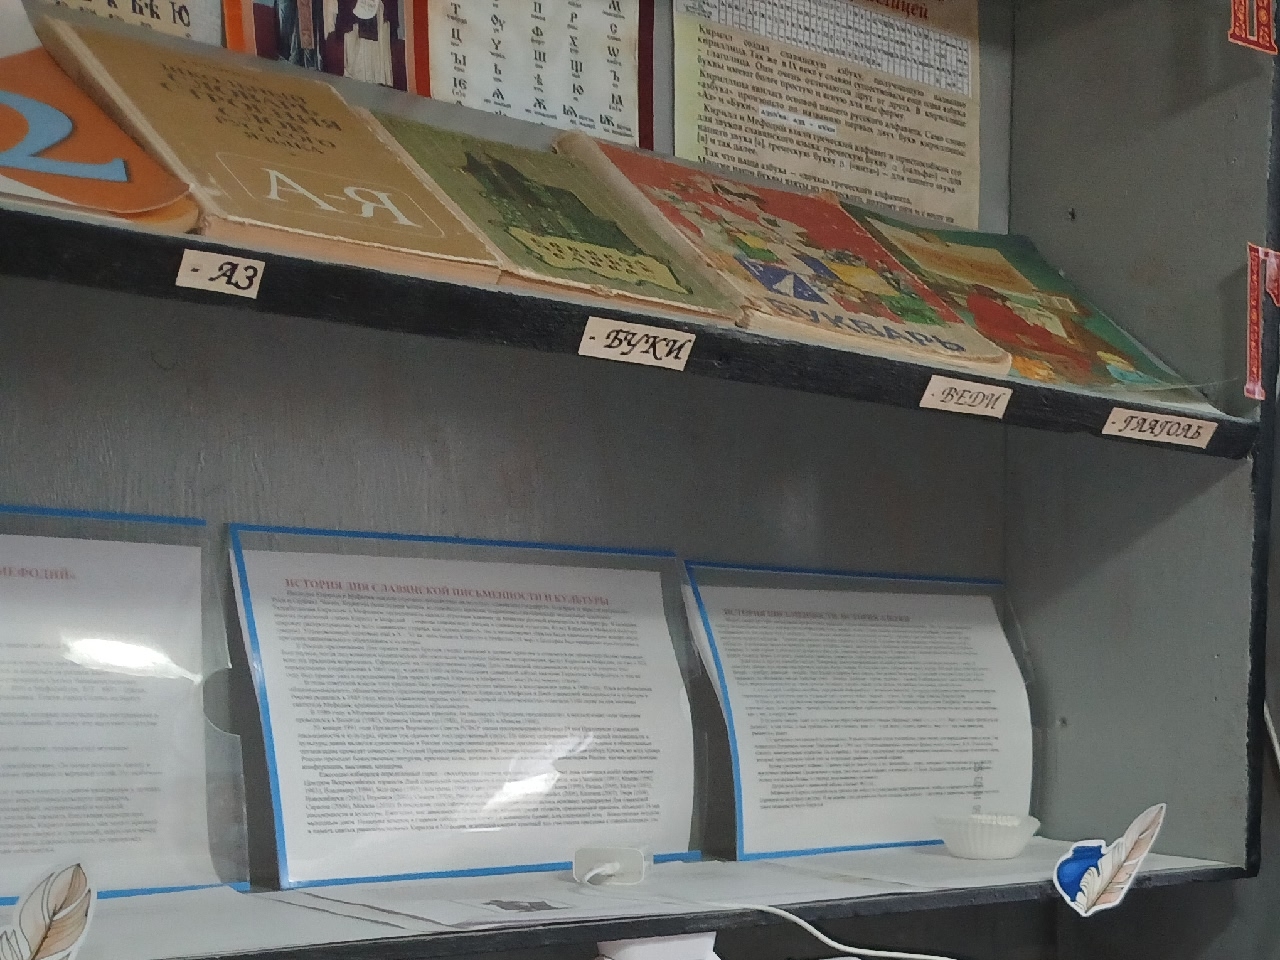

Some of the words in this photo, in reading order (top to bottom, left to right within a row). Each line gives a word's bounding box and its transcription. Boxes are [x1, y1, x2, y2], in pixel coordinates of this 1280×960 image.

[208, 261, 258, 290] АЗ
[766, 296, 966, 351] БУКВАРЬ
[603, 328, 692, 361] БУКИ
[940, 386, 1006, 410] ВЕДИ
[1118, 415, 1203, 440] ГЛАГОЛЬ
